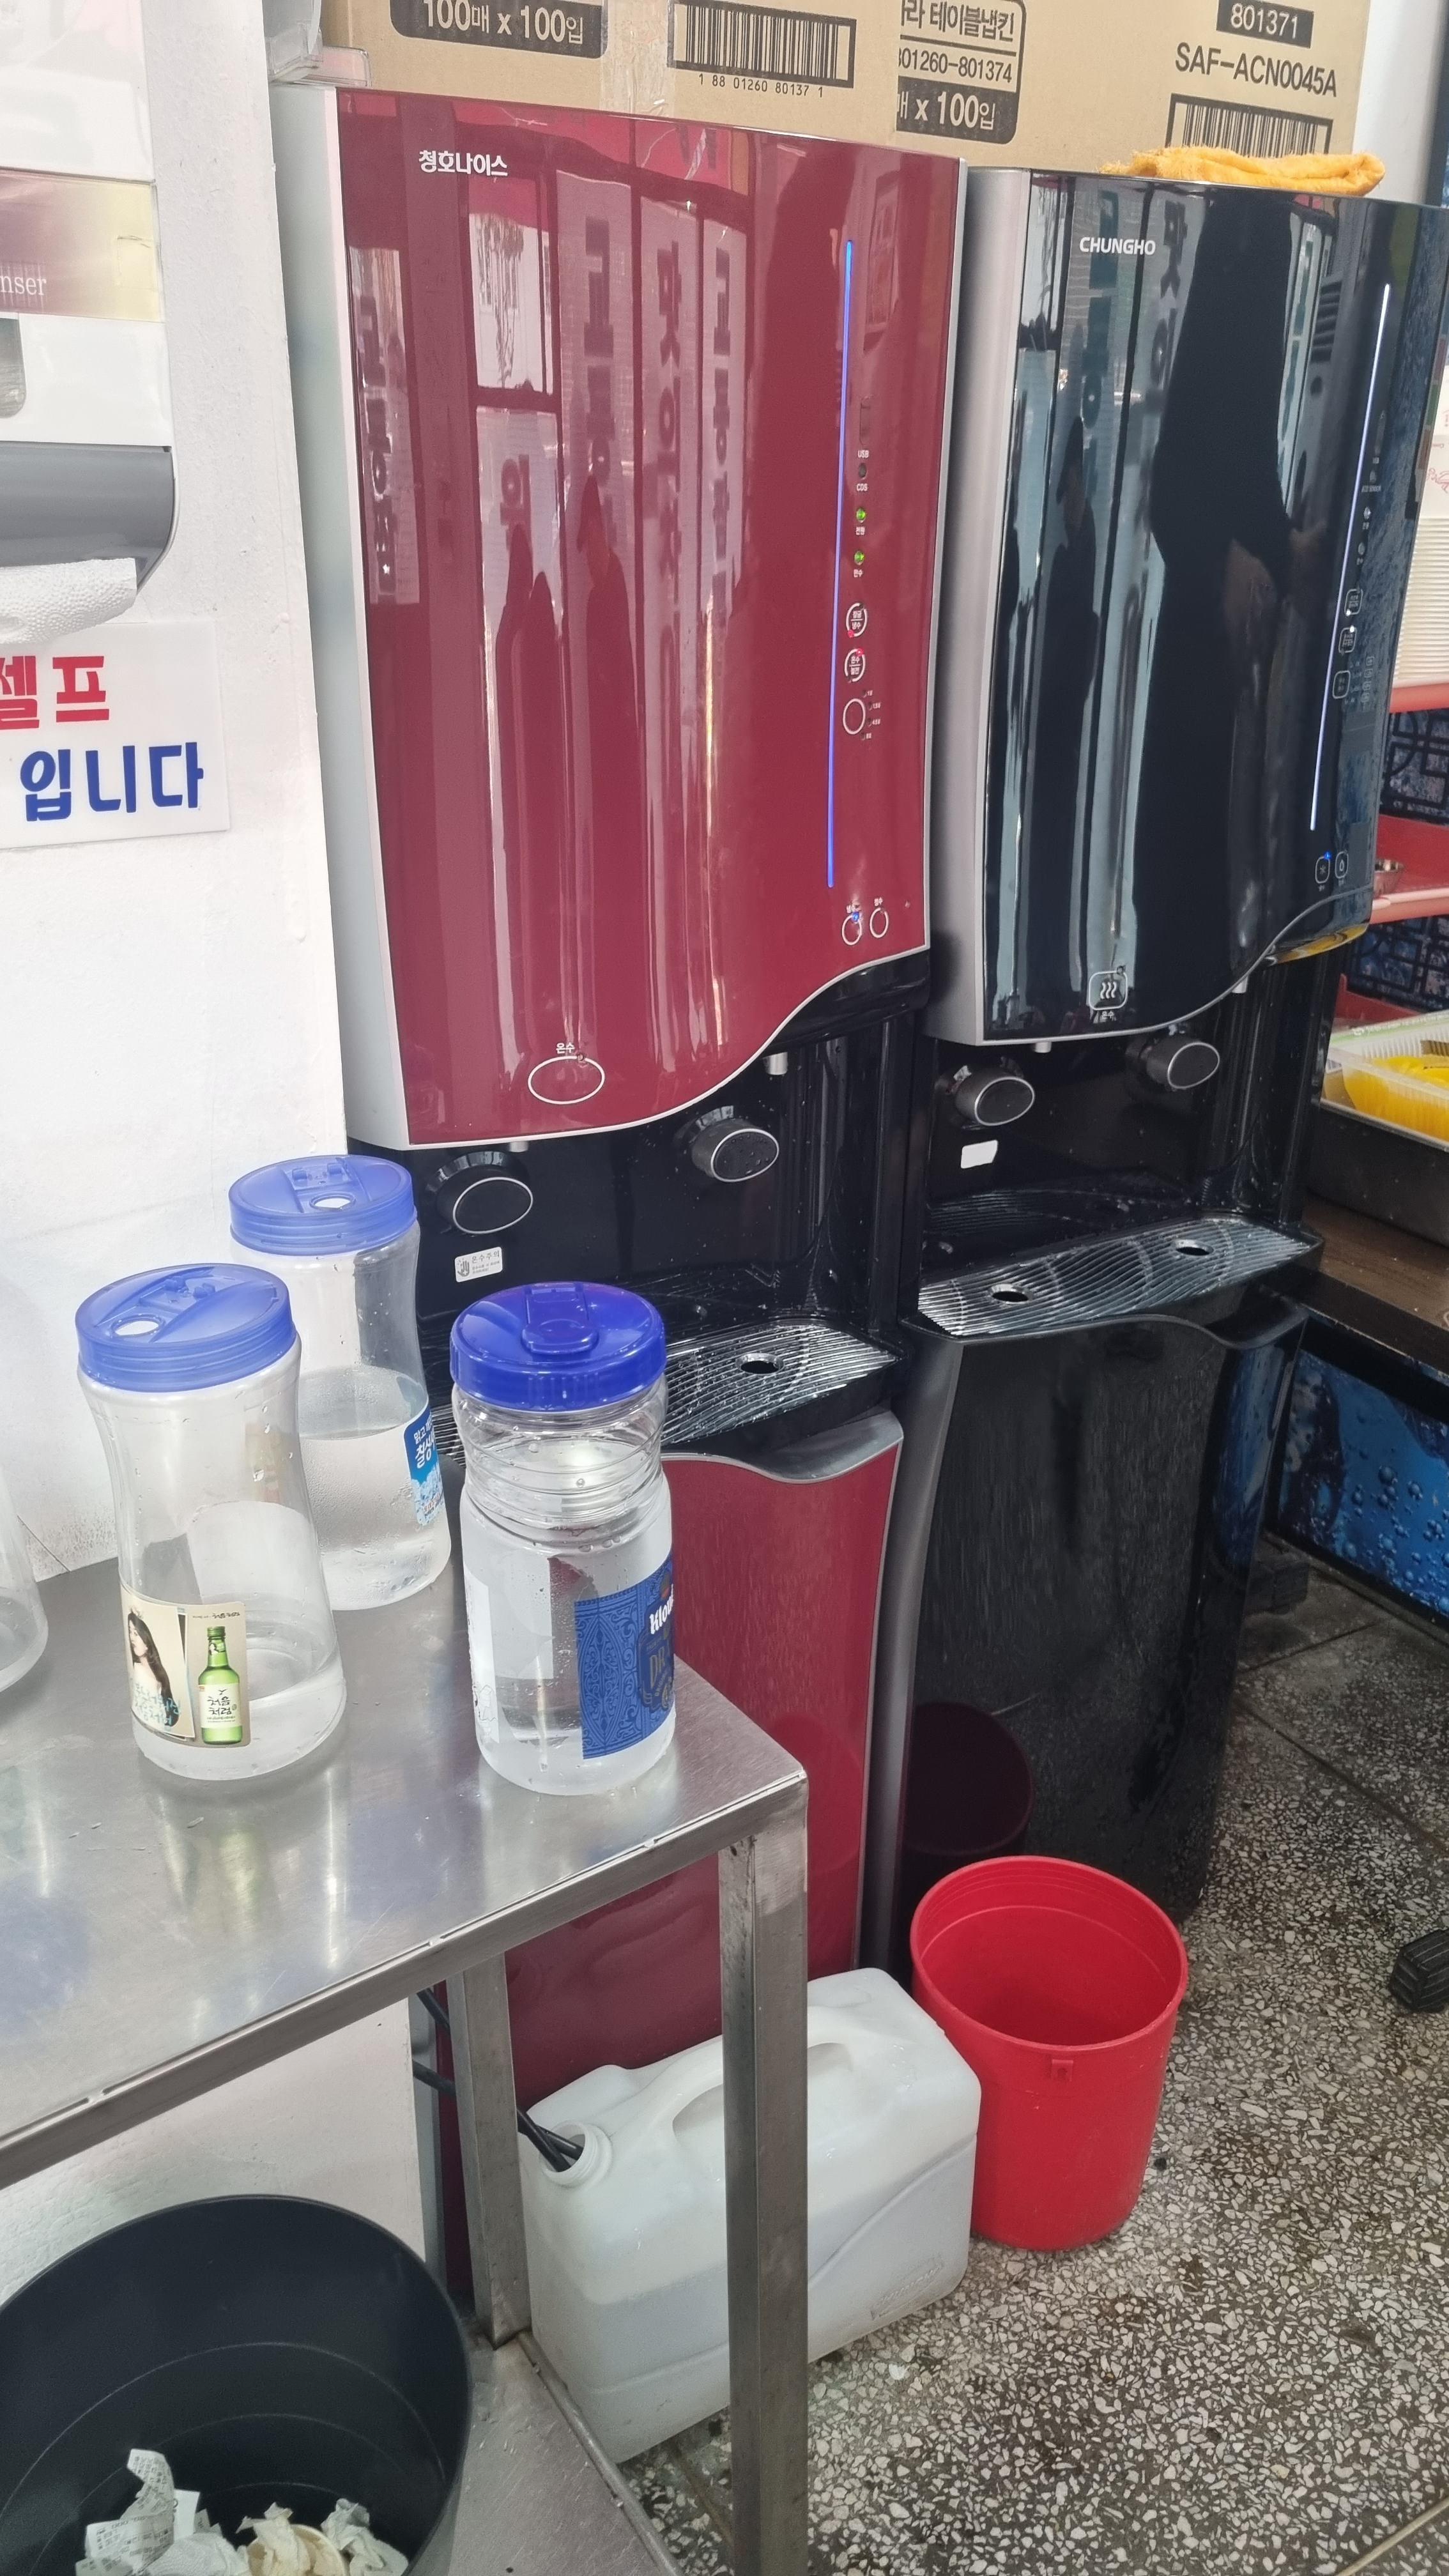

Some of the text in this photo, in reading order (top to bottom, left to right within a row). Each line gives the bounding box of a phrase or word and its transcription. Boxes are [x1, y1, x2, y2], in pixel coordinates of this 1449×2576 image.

[423, 0, 583, 45] 100매 x 100입
[900, 0, 1015, 43] 라 테이블냅킨
[1230, 3, 1299, 39] 801371
[711, 74, 726, 88] 88
[733, 77, 768, 93] 01260
[775, 82, 809, 96] 80137
[1175, 42, 1337, 98] SAF-ACN0045A
[914, 98, 930, 121] x
[937, 91, 996, 131] 100입
[418, 150, 509, 177] 청호나이스
[1078, 236, 1156, 256] CHUNGHO
[0, 655, 110, 730] 셀프
[20, 741, 204, 822] 입니다
[556, 1041, 575, 1054] 온수
[206, 1696, 231, 1706] 처음
[208, 1706, 233, 1716] 처럼
